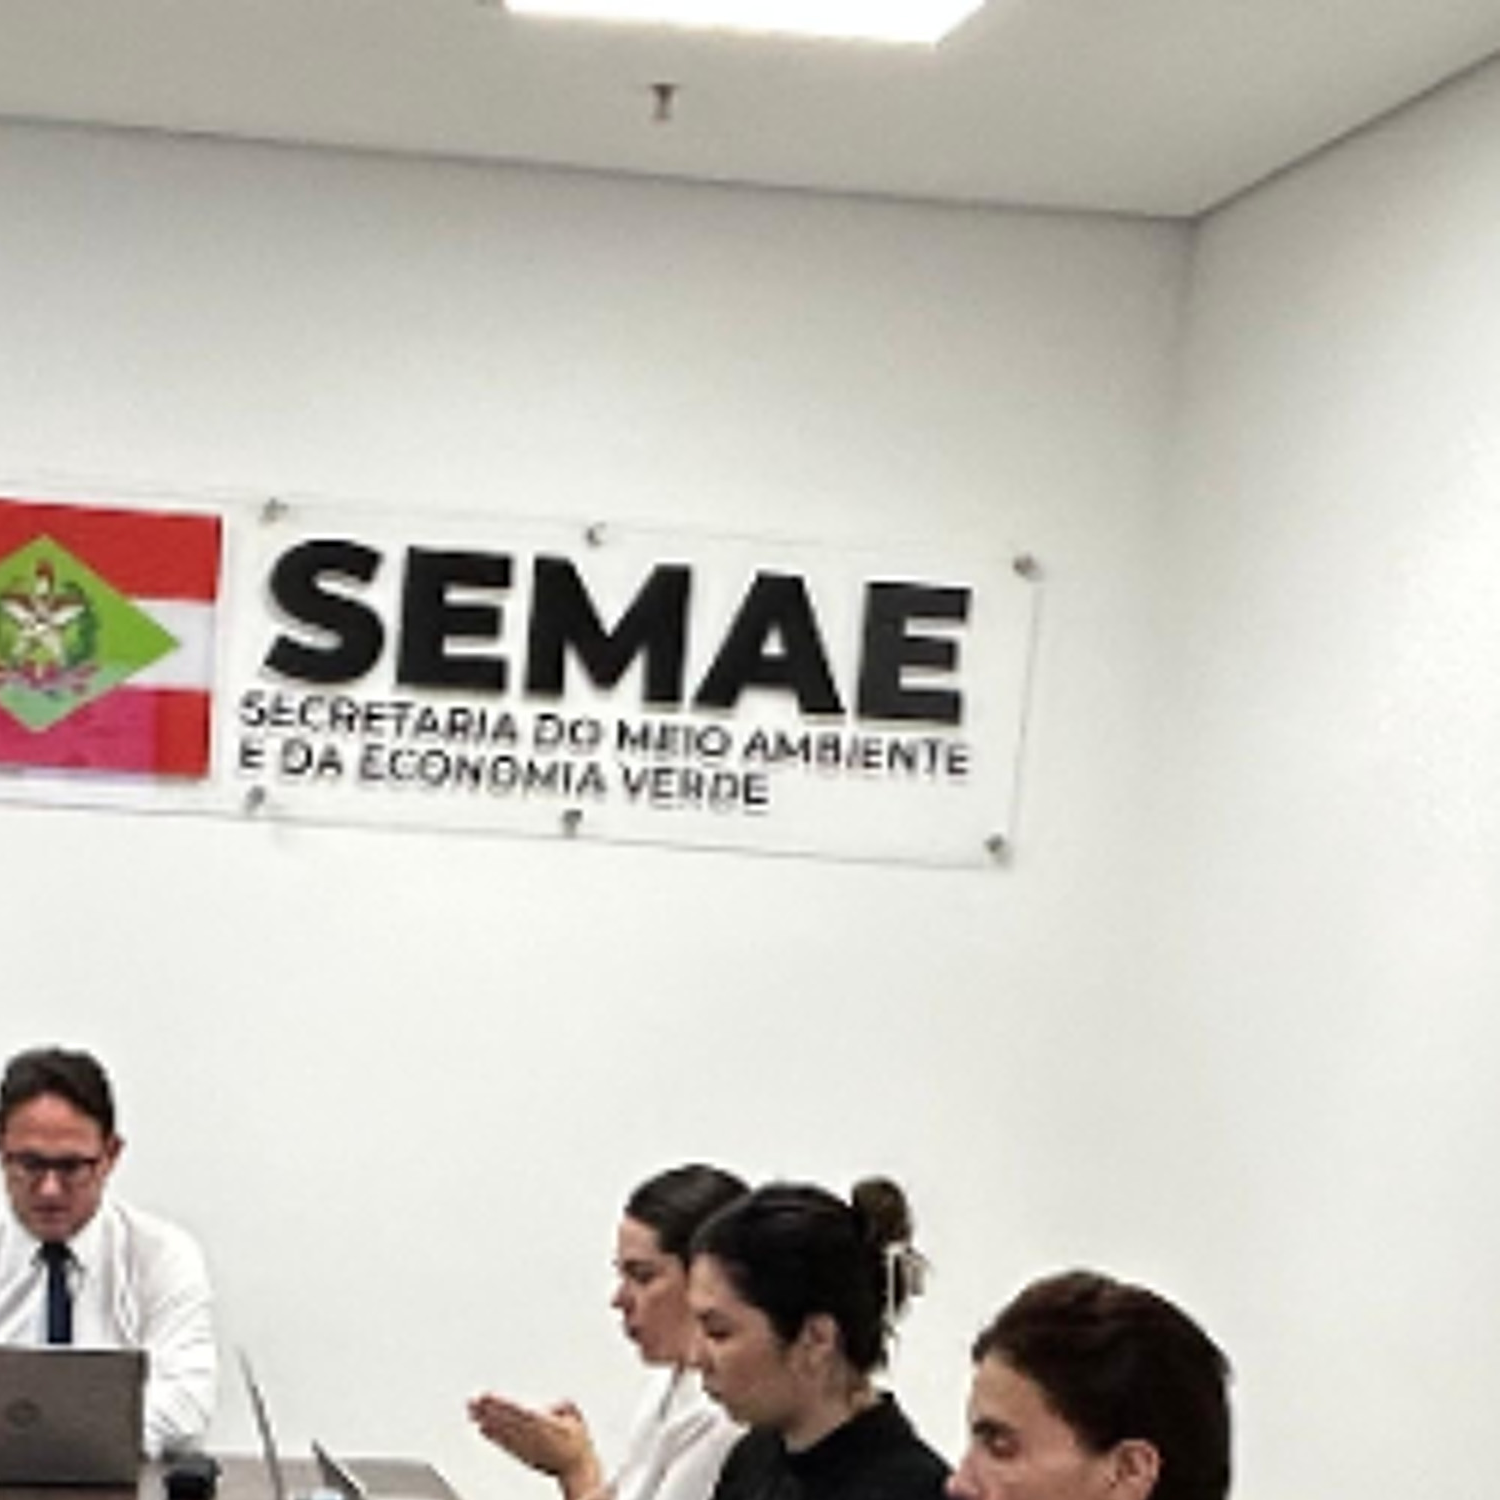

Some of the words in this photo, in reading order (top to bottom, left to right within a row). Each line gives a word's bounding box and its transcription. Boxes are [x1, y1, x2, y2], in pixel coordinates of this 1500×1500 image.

[264, 540, 972, 727] SEMAE
[239, 691, 518, 743] SECRETARIA
[533, 713, 603, 747] DO
[616, 719, 733, 758] MEIO
[743, 730, 969, 776] AMBIENTE
[239, 739, 264, 769] E
[281, 739, 343, 776] DA
[359, 743, 606, 795] ECONOMIA
[622, 766, 769, 806] VERDE
